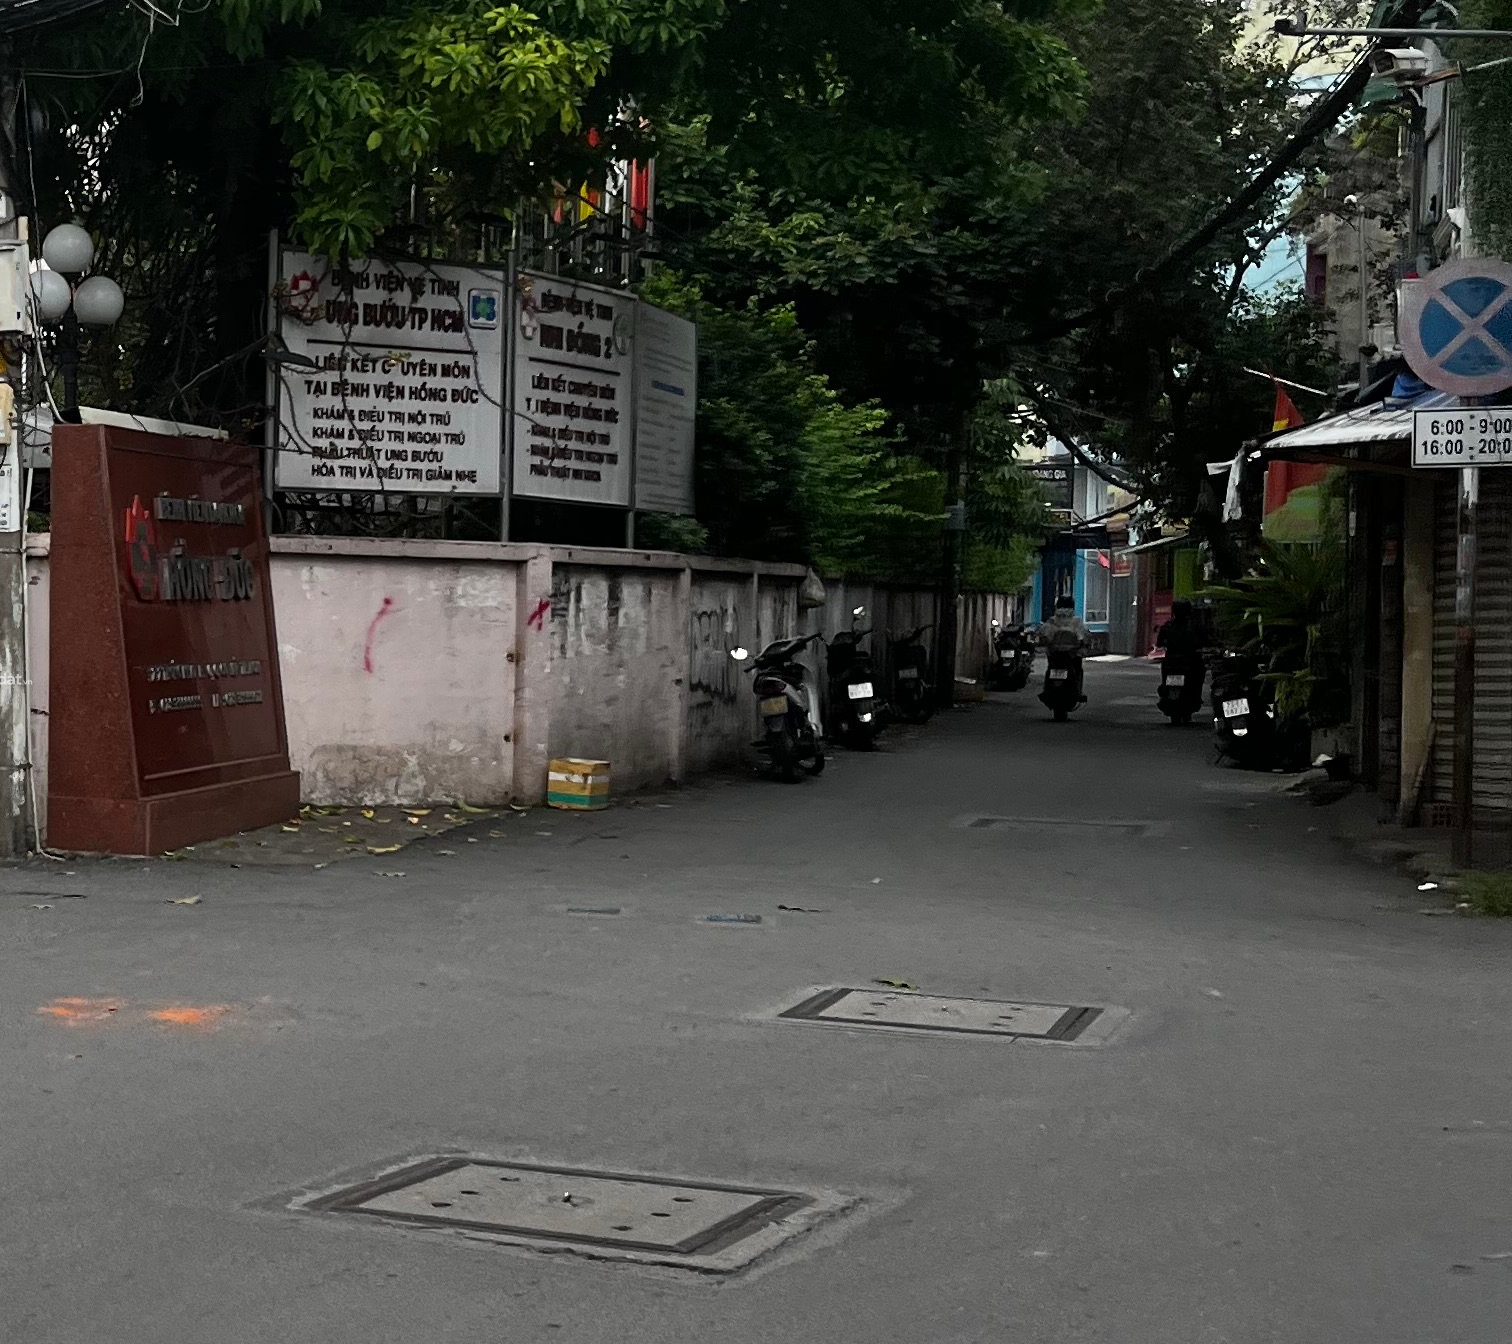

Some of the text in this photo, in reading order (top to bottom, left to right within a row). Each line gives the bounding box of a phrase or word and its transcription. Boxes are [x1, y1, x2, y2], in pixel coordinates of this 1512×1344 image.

[441, 360, 470, 379] MÔN
[304, 380, 327, 398] TẠI
[373, 381, 405, 402] VIỆN
[451, 385, 479, 404] ĐỨC
[313, 405, 345, 420] KHÁM
[387, 411, 405, 426] TRỊ
[313, 425, 345, 439] KHÁM
[387, 430, 404, 444] TRỊ
[1431, 419, 1464, 436] 6:00
[1479, 418, 1512, 434] 9:00
[1422, 439, 1463, 455] 16:00
[1478, 437, 1512, 454] 20:0
[312, 462, 336, 476] HÓA
[339, 465, 357, 479] TRỊ
[405, 468, 423, 482] TRỊ
